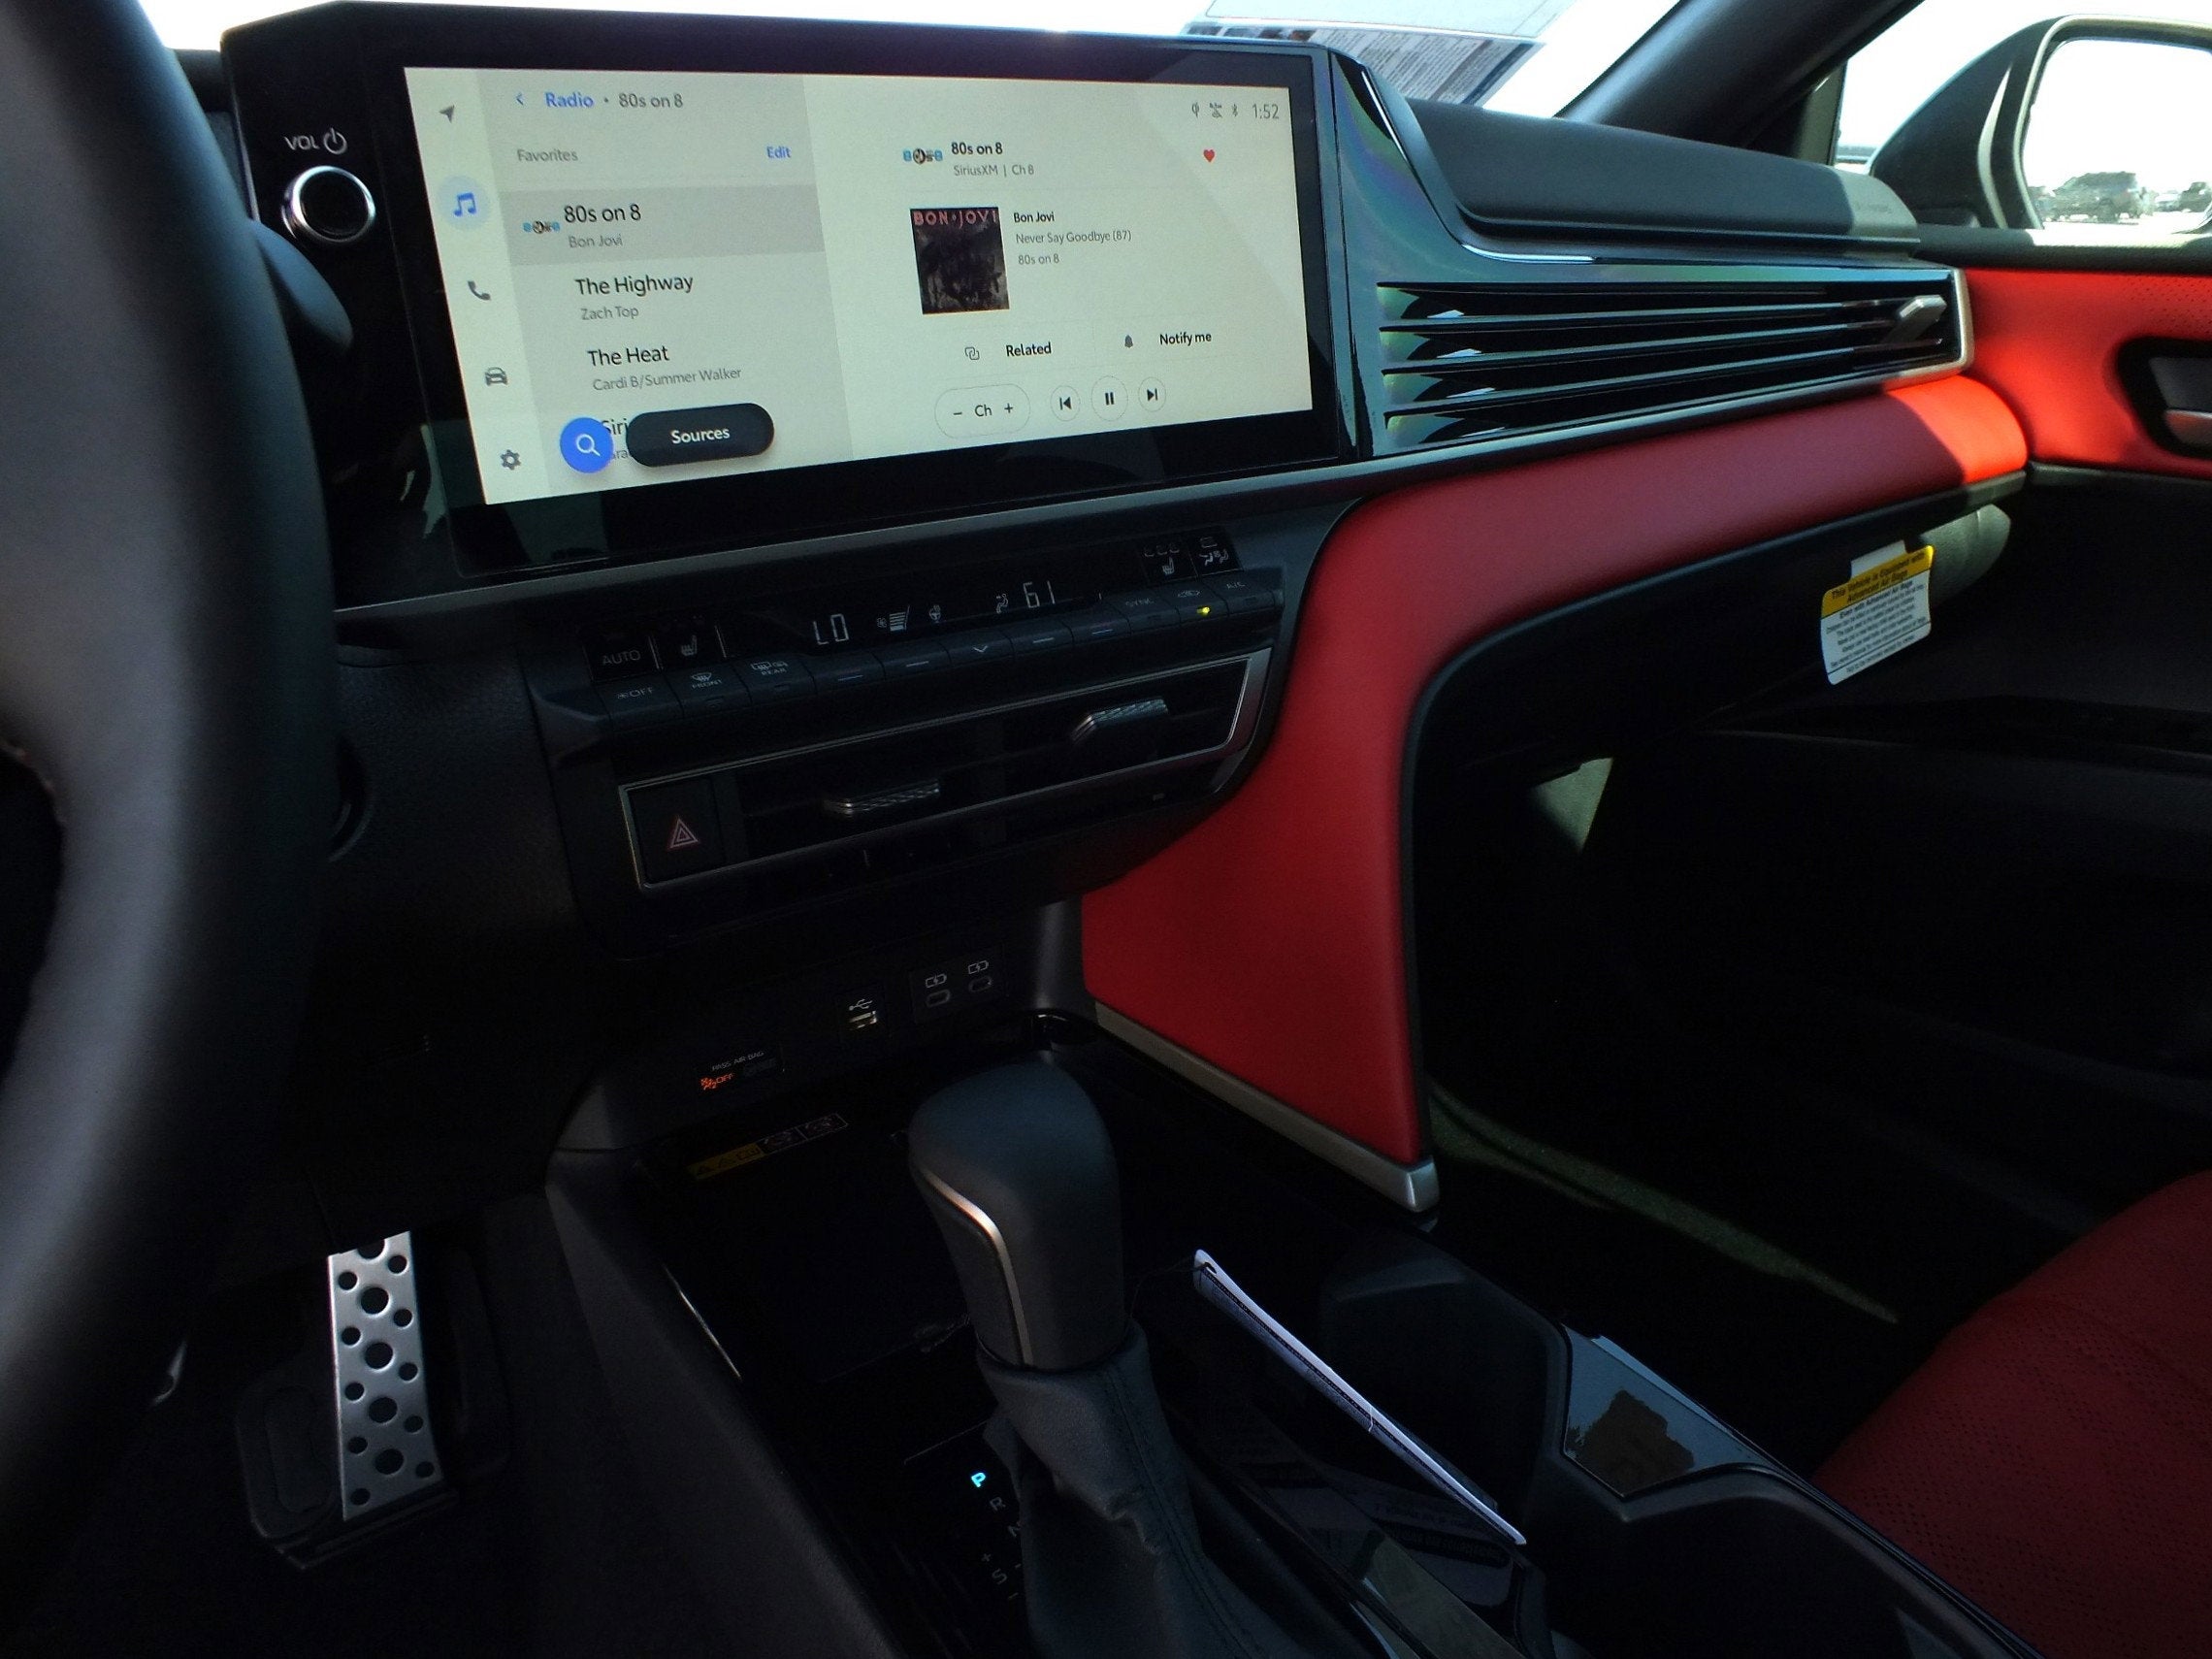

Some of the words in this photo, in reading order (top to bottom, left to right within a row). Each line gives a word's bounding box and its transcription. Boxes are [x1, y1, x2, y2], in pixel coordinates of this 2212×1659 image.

[544, 91, 595, 110] Radio
[618, 93, 647, 109] 80s
[650, 96, 670, 109] on
[673, 93, 684, 109] 8
[1252, 102, 1280, 119] 1:52
[283, 134, 320, 150] VOL
[951, 141, 974, 155] 80s
[976, 145, 993, 155] on
[994, 141, 1004, 155] 8
[516, 147, 579, 164] Favorites
[765, 145, 792, 160] Edit
[953, 163, 998, 177] SiriusXM
[1011, 164, 1026, 176] Ch
[1027, 165, 1035, 176] 8
[563, 205, 598, 223] 80s
[602, 207, 626, 222] on
[630, 203, 641, 221] 8
[913, 210, 949, 226] BON
[959, 209, 997, 229] JOVI
[1013, 211, 1034, 223] Bon
[1035, 211, 1056, 223] Jovi
[568, 235, 596, 248] Bon
[598, 233, 624, 247] Jovi
[1015, 232, 1045, 244] Never
[1047, 230, 1064, 245] Say
[1065, 228, 1111, 244] Goodbye
[1112, 229, 1132, 243] (87)
[1018, 254, 1036, 265] 80s
[1038, 255, 1052, 265] on
[1053, 254, 1060, 265] 8
[574, 277, 611, 296] The
[613, 273, 695, 296] Highway
[580, 305, 612, 321] Zach
[614, 304, 639, 321] Top
[1158, 333, 1193, 347] Notify
[1194, 333, 1213, 343] me
[586, 347, 622, 367] The
[625, 344, 670, 365] Heat
[1005, 341, 1054, 358] Related
[592, 374, 628, 391] Cardi
[630, 371, 697, 389] B/Summer
[699, 366, 742, 383] Walker
[973, 404, 992, 418] Ch
[669, 427, 732, 445] Sources
[1022, 580, 1056, 610] 61
[812, 612, 850, 646] LO
[602, 648, 642, 667] AUTO
[971, 1472, 987, 1488] P
[990, 1496, 1006, 1512] R
[991, 1568, 1008, 1585] S
